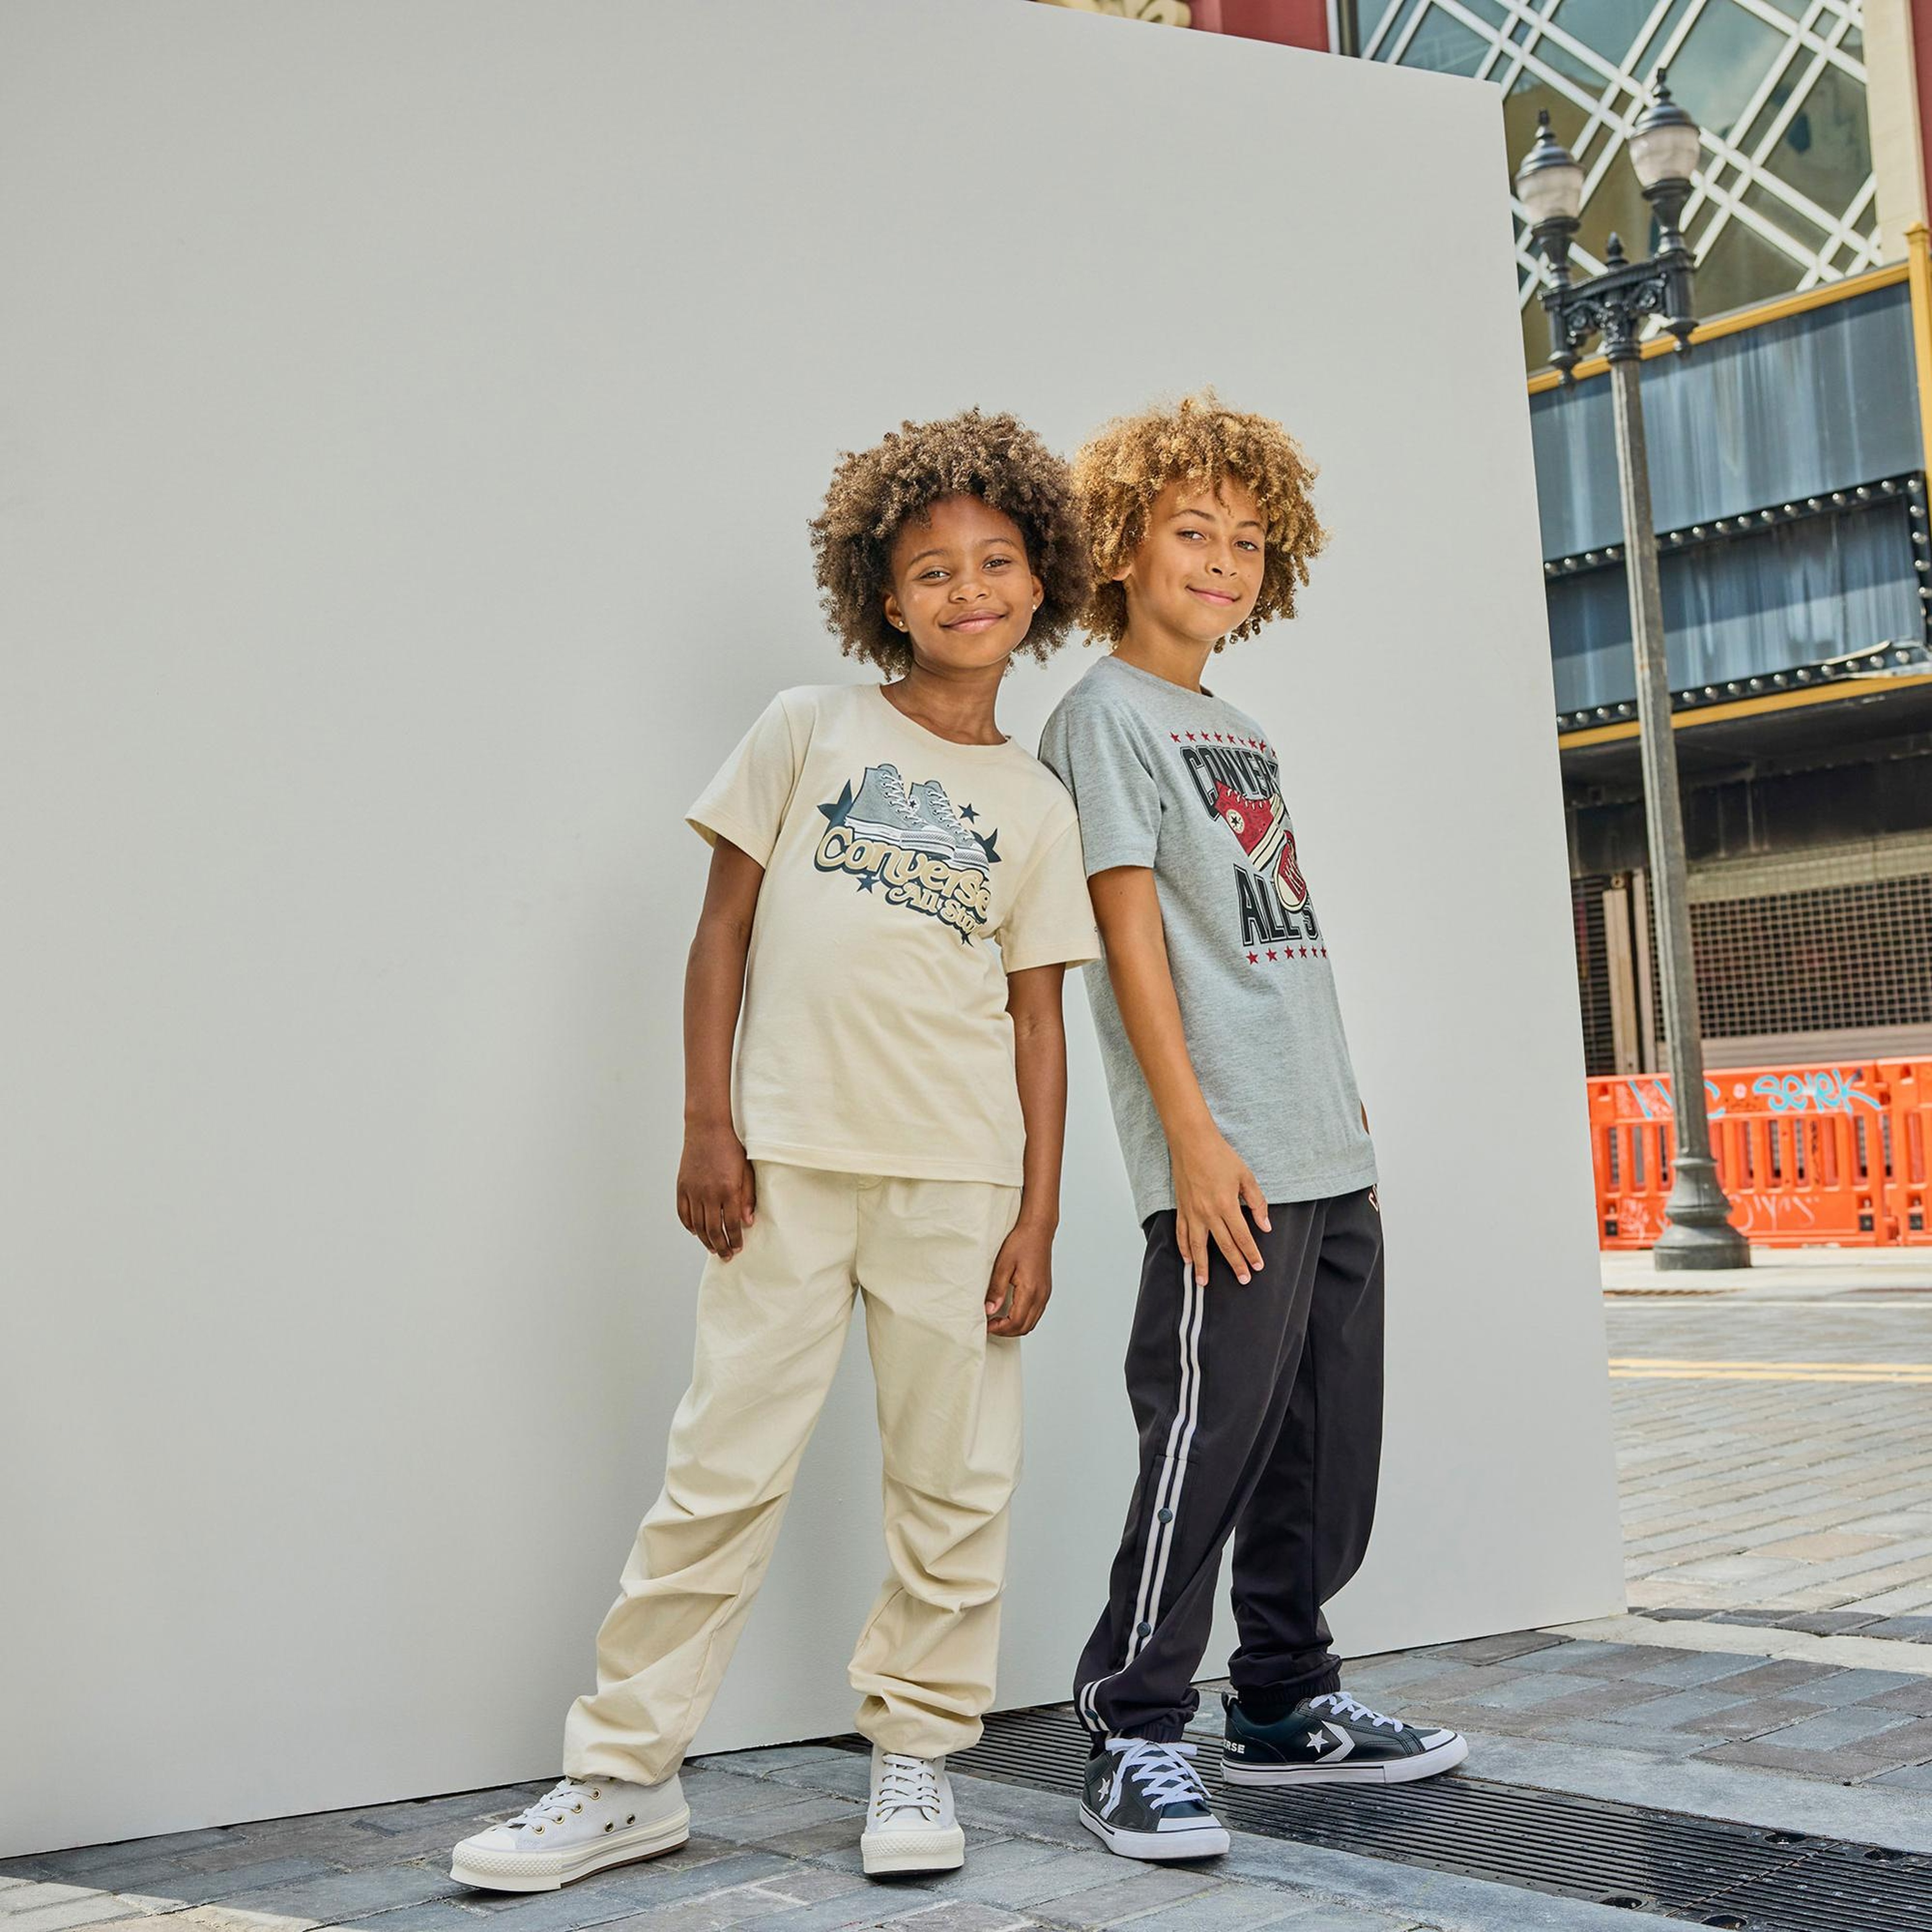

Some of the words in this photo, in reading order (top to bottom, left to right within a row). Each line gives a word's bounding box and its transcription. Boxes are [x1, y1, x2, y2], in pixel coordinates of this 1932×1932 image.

[814, 826, 990, 924] Converse
[886, 881, 939, 916] All
[1233, 863, 1302, 946] ALL
